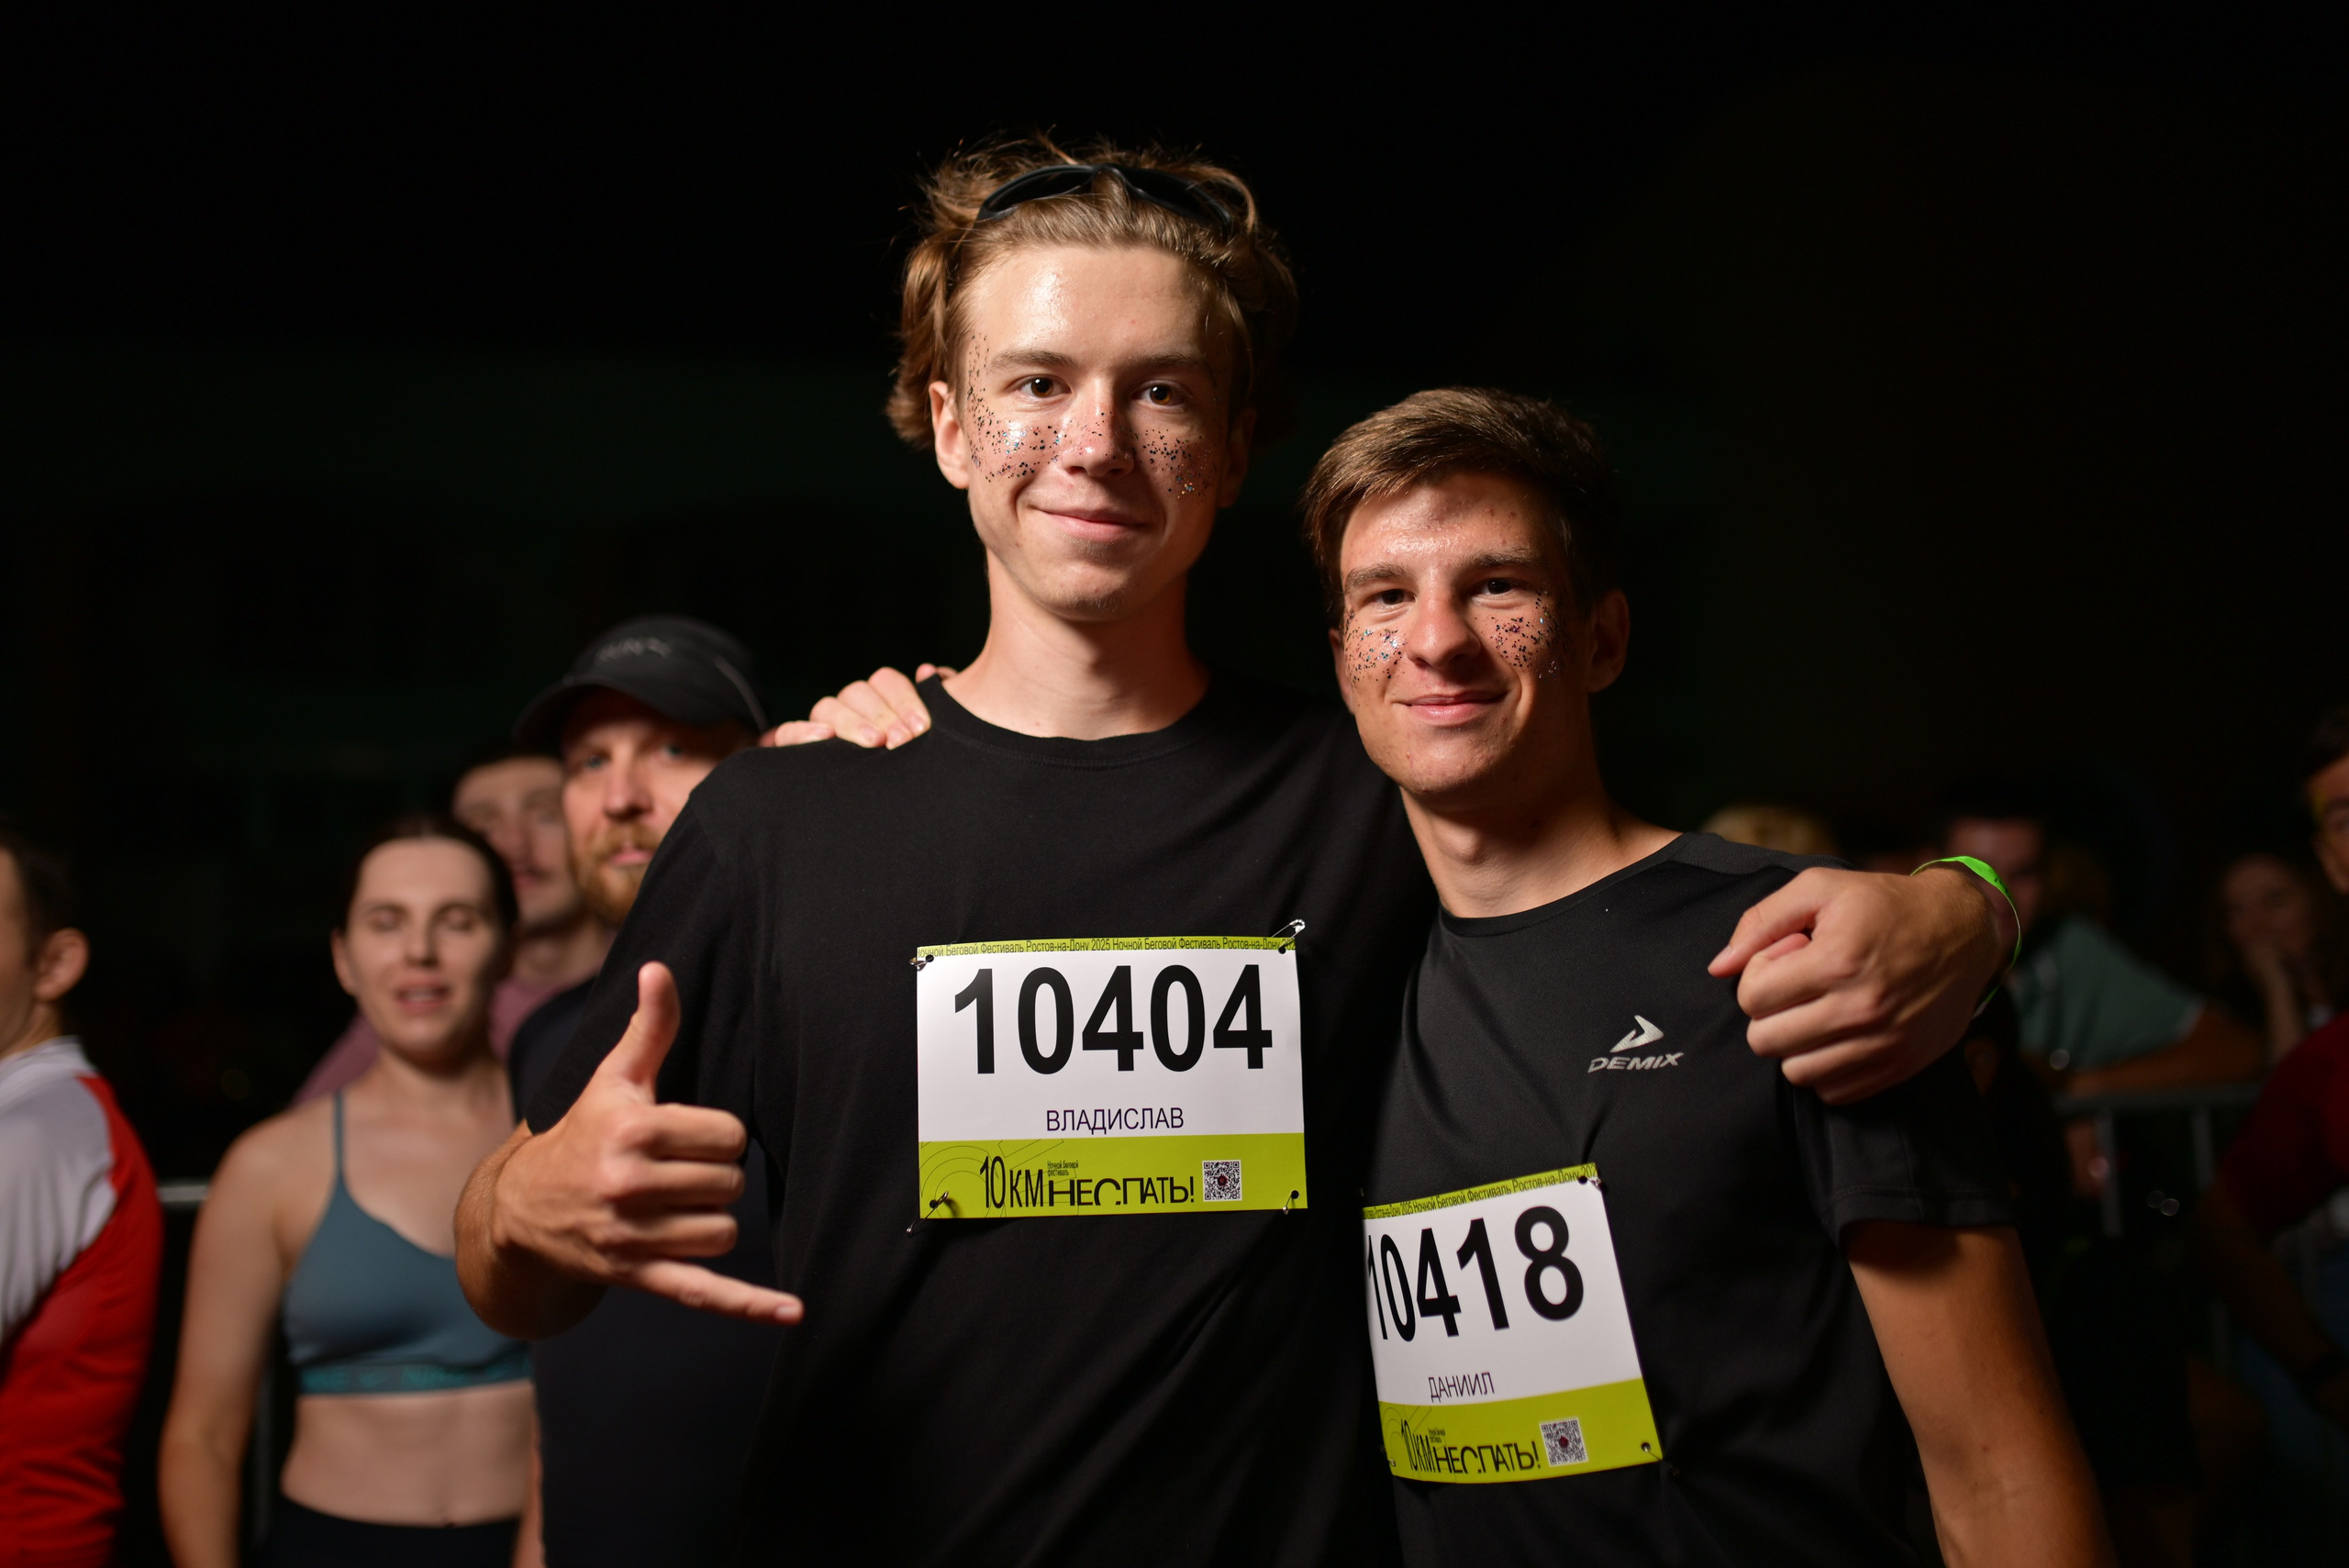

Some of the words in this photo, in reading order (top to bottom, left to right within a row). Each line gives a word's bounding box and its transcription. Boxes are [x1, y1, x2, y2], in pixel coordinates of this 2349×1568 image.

[946, 943, 978, 956] Беговой
[981, 942, 1025, 954] Фестиваль
[1027, 940, 1089, 952] Ростов-на-Дону
[1091, 939, 1110, 951] 2025
[1113, 938, 1142, 951] Ночной
[1145, 938, 1177, 950] Беговой
[1179, 938, 1221, 950] Фестиваль
[1223, 937, 1279, 951] Ростов-на-Дону
[954, 964, 1273, 1074] 10404
[1587, 1052, 1685, 1073] DEMIX
[1046, 1107, 1184, 1135] ВЛАДИСЛАВ
[1414, 1197, 1436, 1213] Ночной
[1436, 1189, 1466, 1209] Беговой
[1467, 1184, 1512, 1202] Фестиваль
[1512, 1169, 1579, 1194] Ростов-на-Дону
[1367, 1206, 1584, 1342] 10418
[1428, 1372, 1495, 1403] ДАНИИЛ
